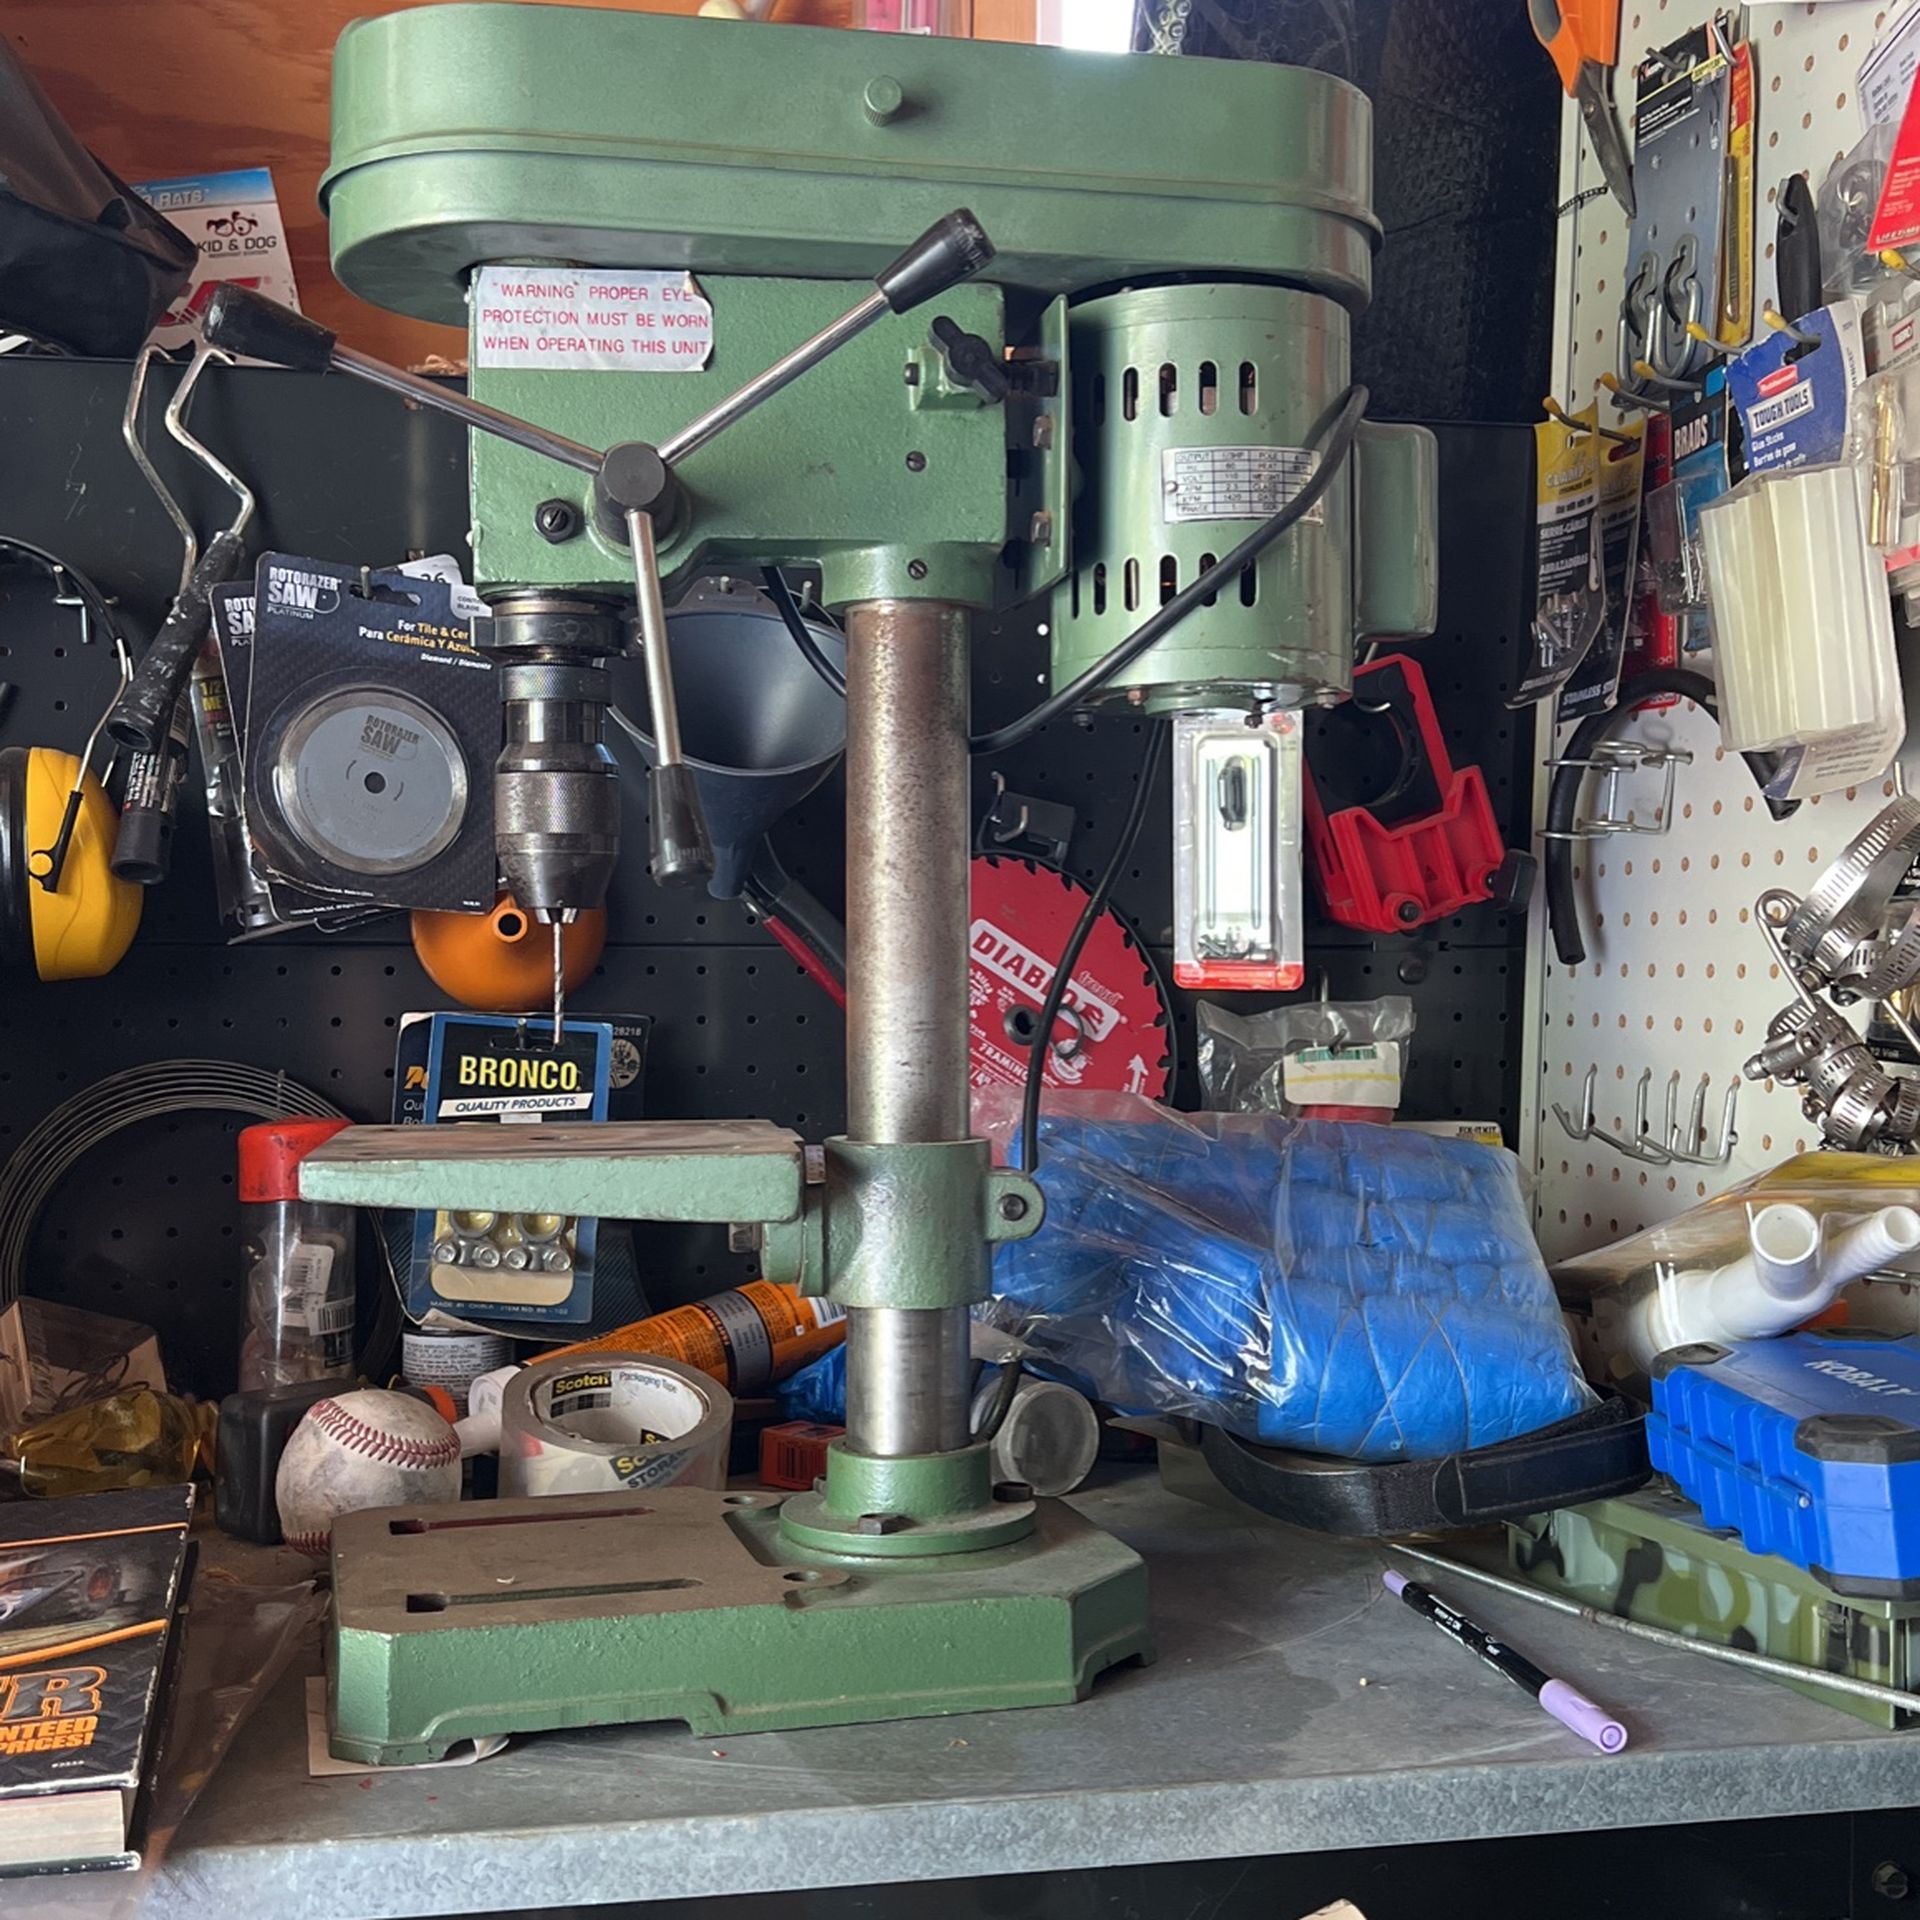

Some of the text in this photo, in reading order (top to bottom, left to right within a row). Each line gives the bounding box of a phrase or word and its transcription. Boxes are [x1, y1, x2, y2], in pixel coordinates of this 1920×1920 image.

[159, 189, 203, 206] RATS
[198, 236, 277, 252] KID & DOG
[589, 286, 648, 300] PROPER
[662, 287, 693, 302] EYE
[483, 309, 708, 328] PROTECTION MUST BE WORN
[483, 336, 708, 354] WHEN OPERATING THIS UNIT
[1674, 414, 1708, 460] BRADS
[269, 566, 338, 591] ROTORAZER
[268, 581, 318, 608] SAW
[227, 610, 255, 635] SA
[266, 605, 315, 620] PLATINUM
[359, 625, 385, 641] Para
[436, 638, 447, 649] Y
[398, 618, 469, 640] For Tile & Cer
[361, 725, 402, 755] SAW
[366, 714, 420, 744] ROTORAZER
[458, 1055, 578, 1091] BRONCO
[455, 1097, 576, 1113] QUALITY PRODUCTS
[555, 1373, 609, 1394] Scotch
[1803, 1360, 1920, 1396] KOBALT
